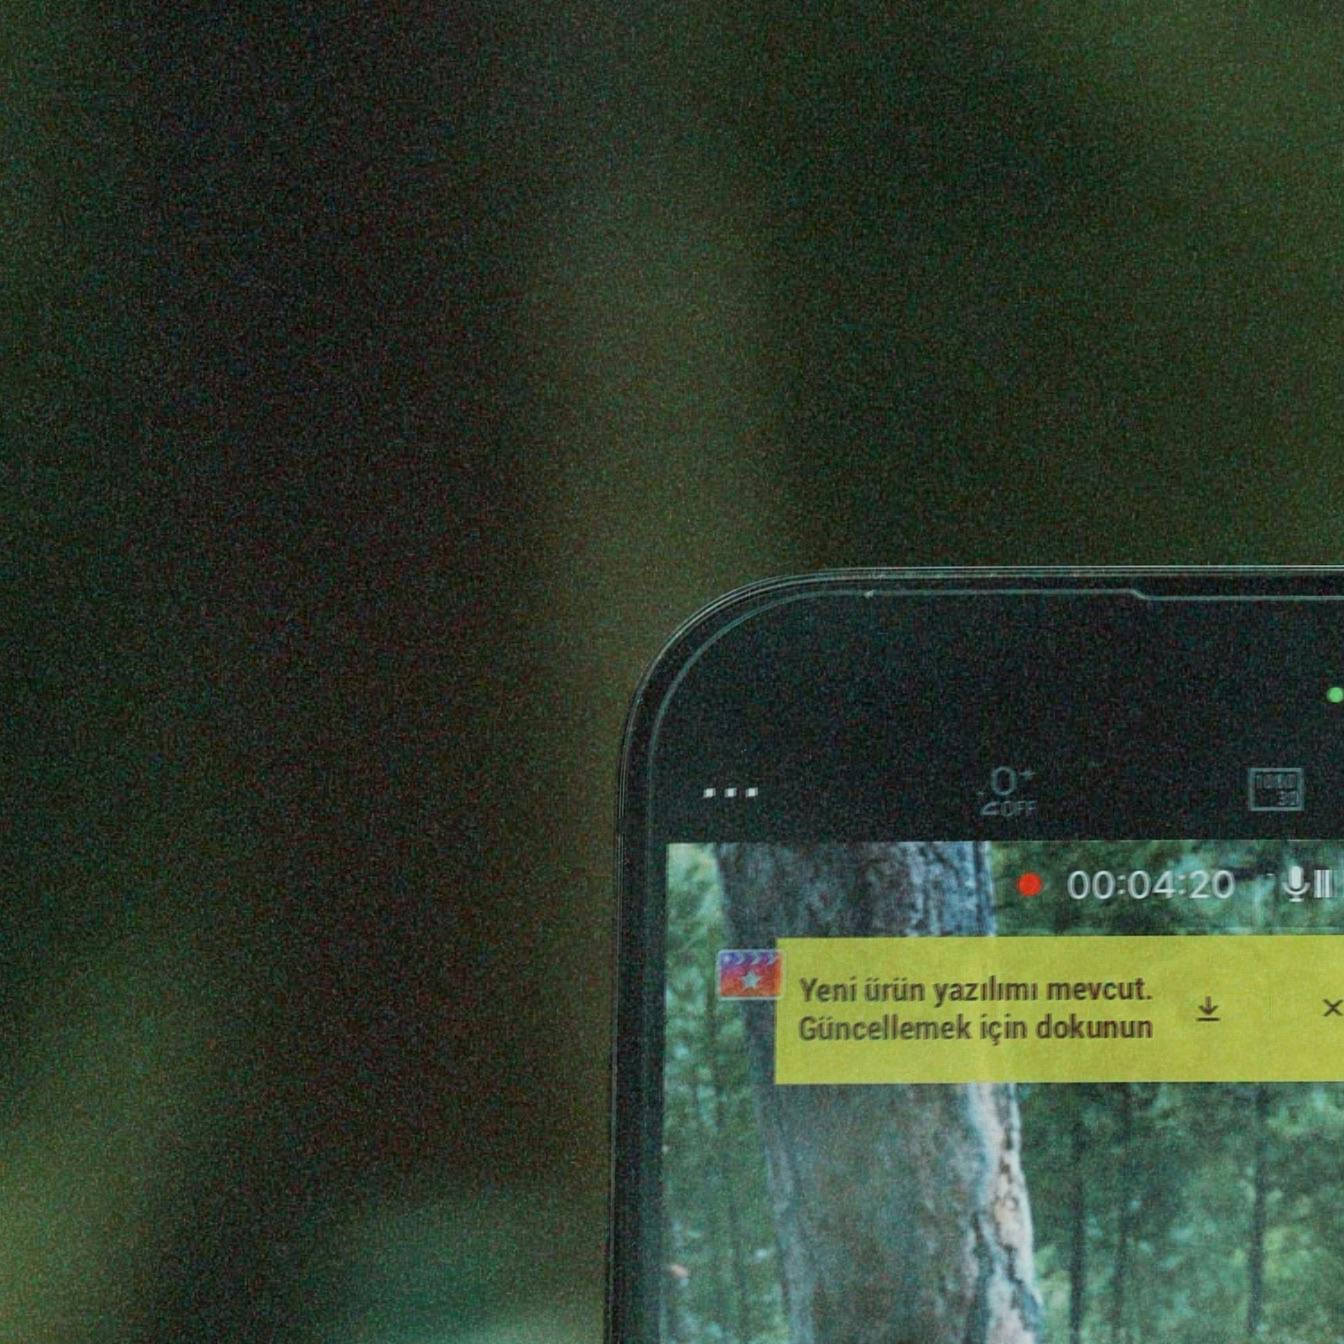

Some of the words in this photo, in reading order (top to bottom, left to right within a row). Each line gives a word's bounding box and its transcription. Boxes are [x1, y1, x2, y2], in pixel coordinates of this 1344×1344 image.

[1066, 869, 1236, 900] 00:04:20
[799, 975, 857, 1002] Yeni
[864, 977, 925, 1002] ürün
[933, 975, 1038, 1008] yazılımı
[1047, 977, 1153, 1001] mevcut.
[798, 1013, 972, 1041] Güncellemek
[980, 1013, 1028, 1046] için
[1035, 1012, 1153, 1039] dokunun
